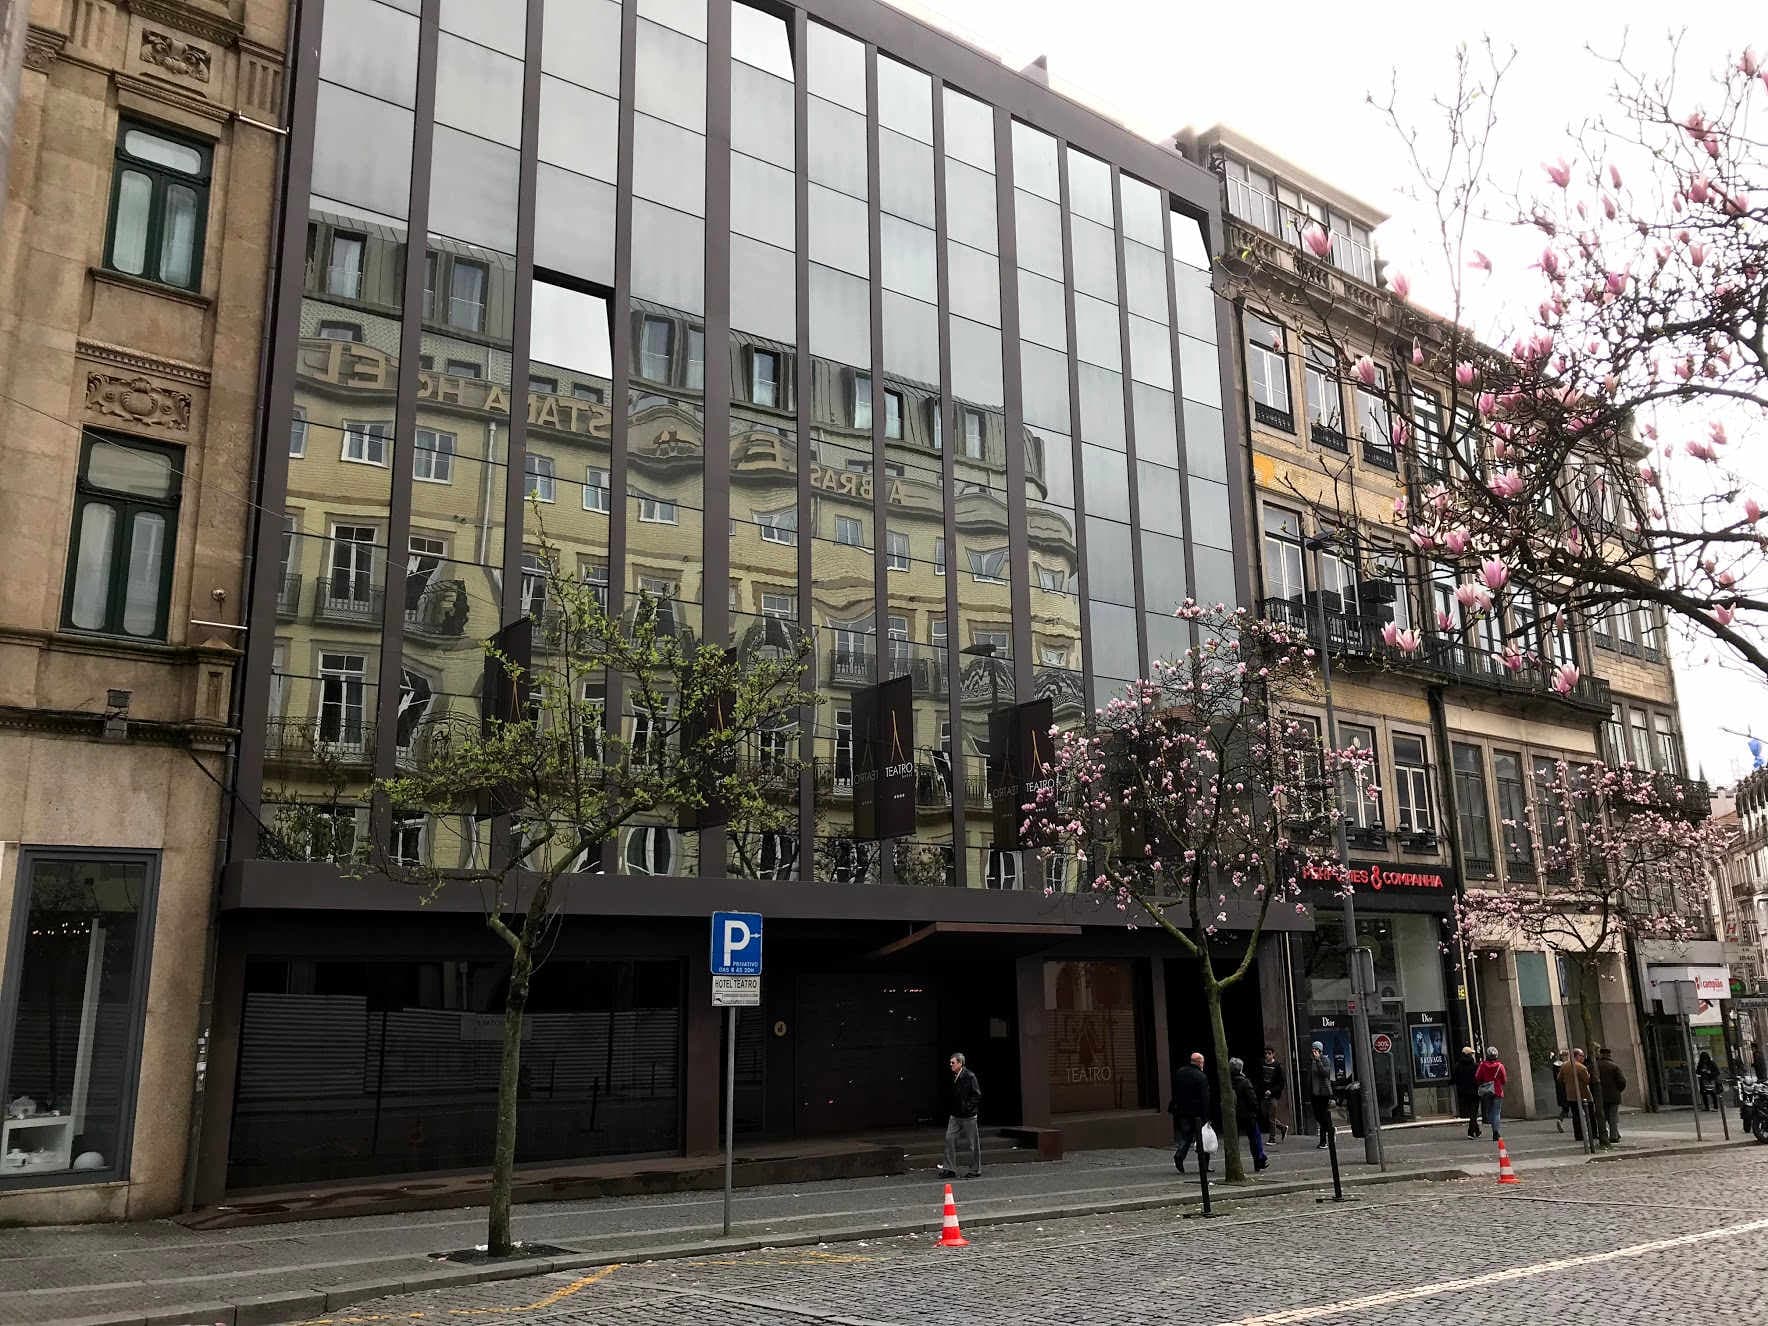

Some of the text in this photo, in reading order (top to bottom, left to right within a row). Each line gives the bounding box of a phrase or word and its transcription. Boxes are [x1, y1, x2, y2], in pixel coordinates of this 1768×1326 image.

[885, 762, 914, 778] TEATRO
[1370, 864, 1383, 890] &
[1382, 871, 1444, 888] COMPANHIA
[724, 920, 750, 967] P
[714, 979, 758, 989] HOTEL TEATRO
[1322, 1016, 1335, 1027] Dior
[1421, 1012, 1433, 1023] Dior
[1065, 1065, 1112, 1083] TEATRO
